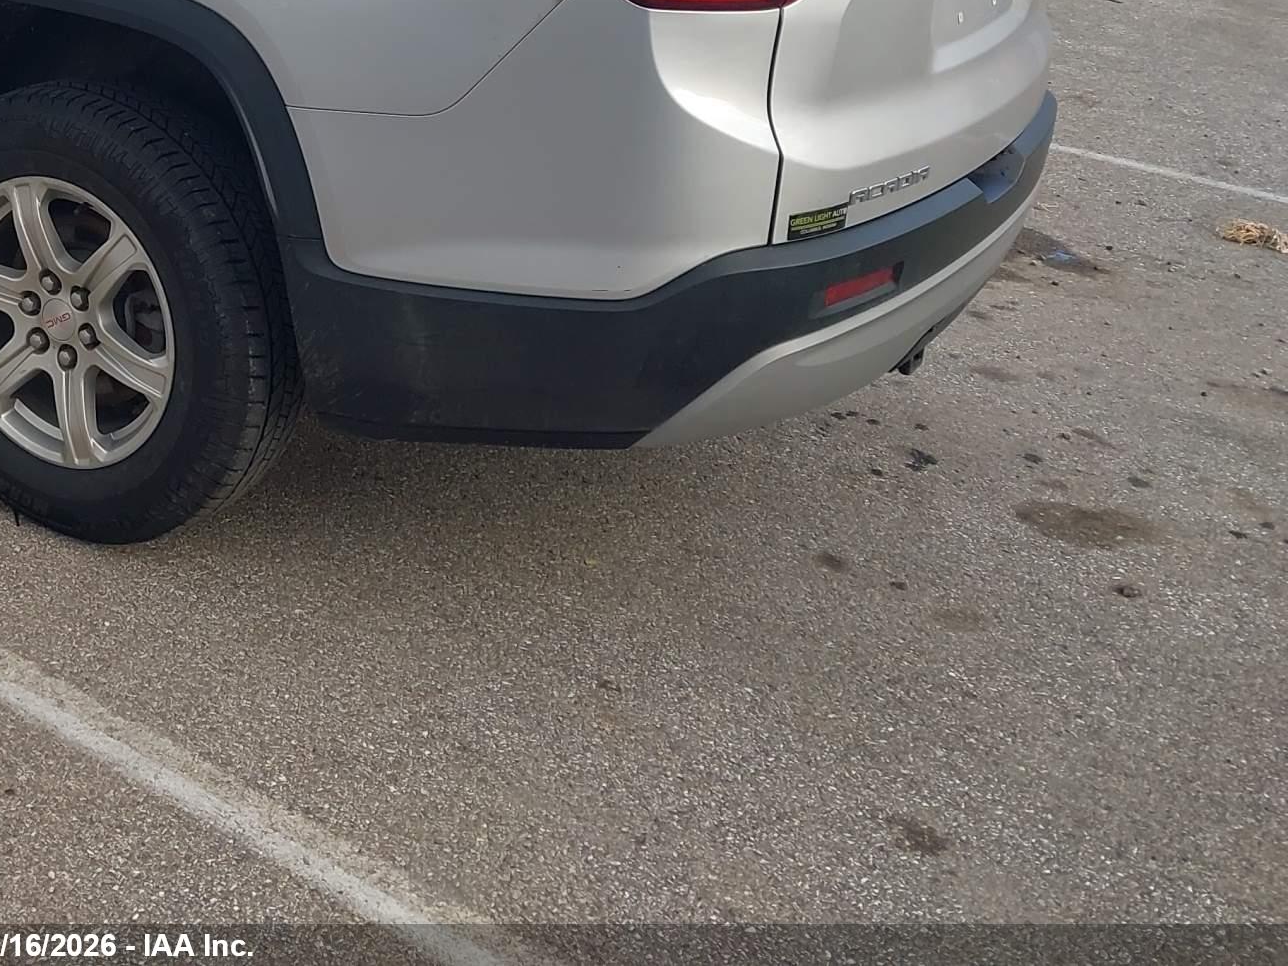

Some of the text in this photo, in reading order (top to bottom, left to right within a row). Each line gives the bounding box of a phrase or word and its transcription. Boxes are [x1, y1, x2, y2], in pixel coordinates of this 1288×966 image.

[849, 165, 930, 205] ACADIA
[790, 216, 813, 227] GREEN
[814, 211, 832, 222] LIGHT
[45, 312, 71, 329] GMC
